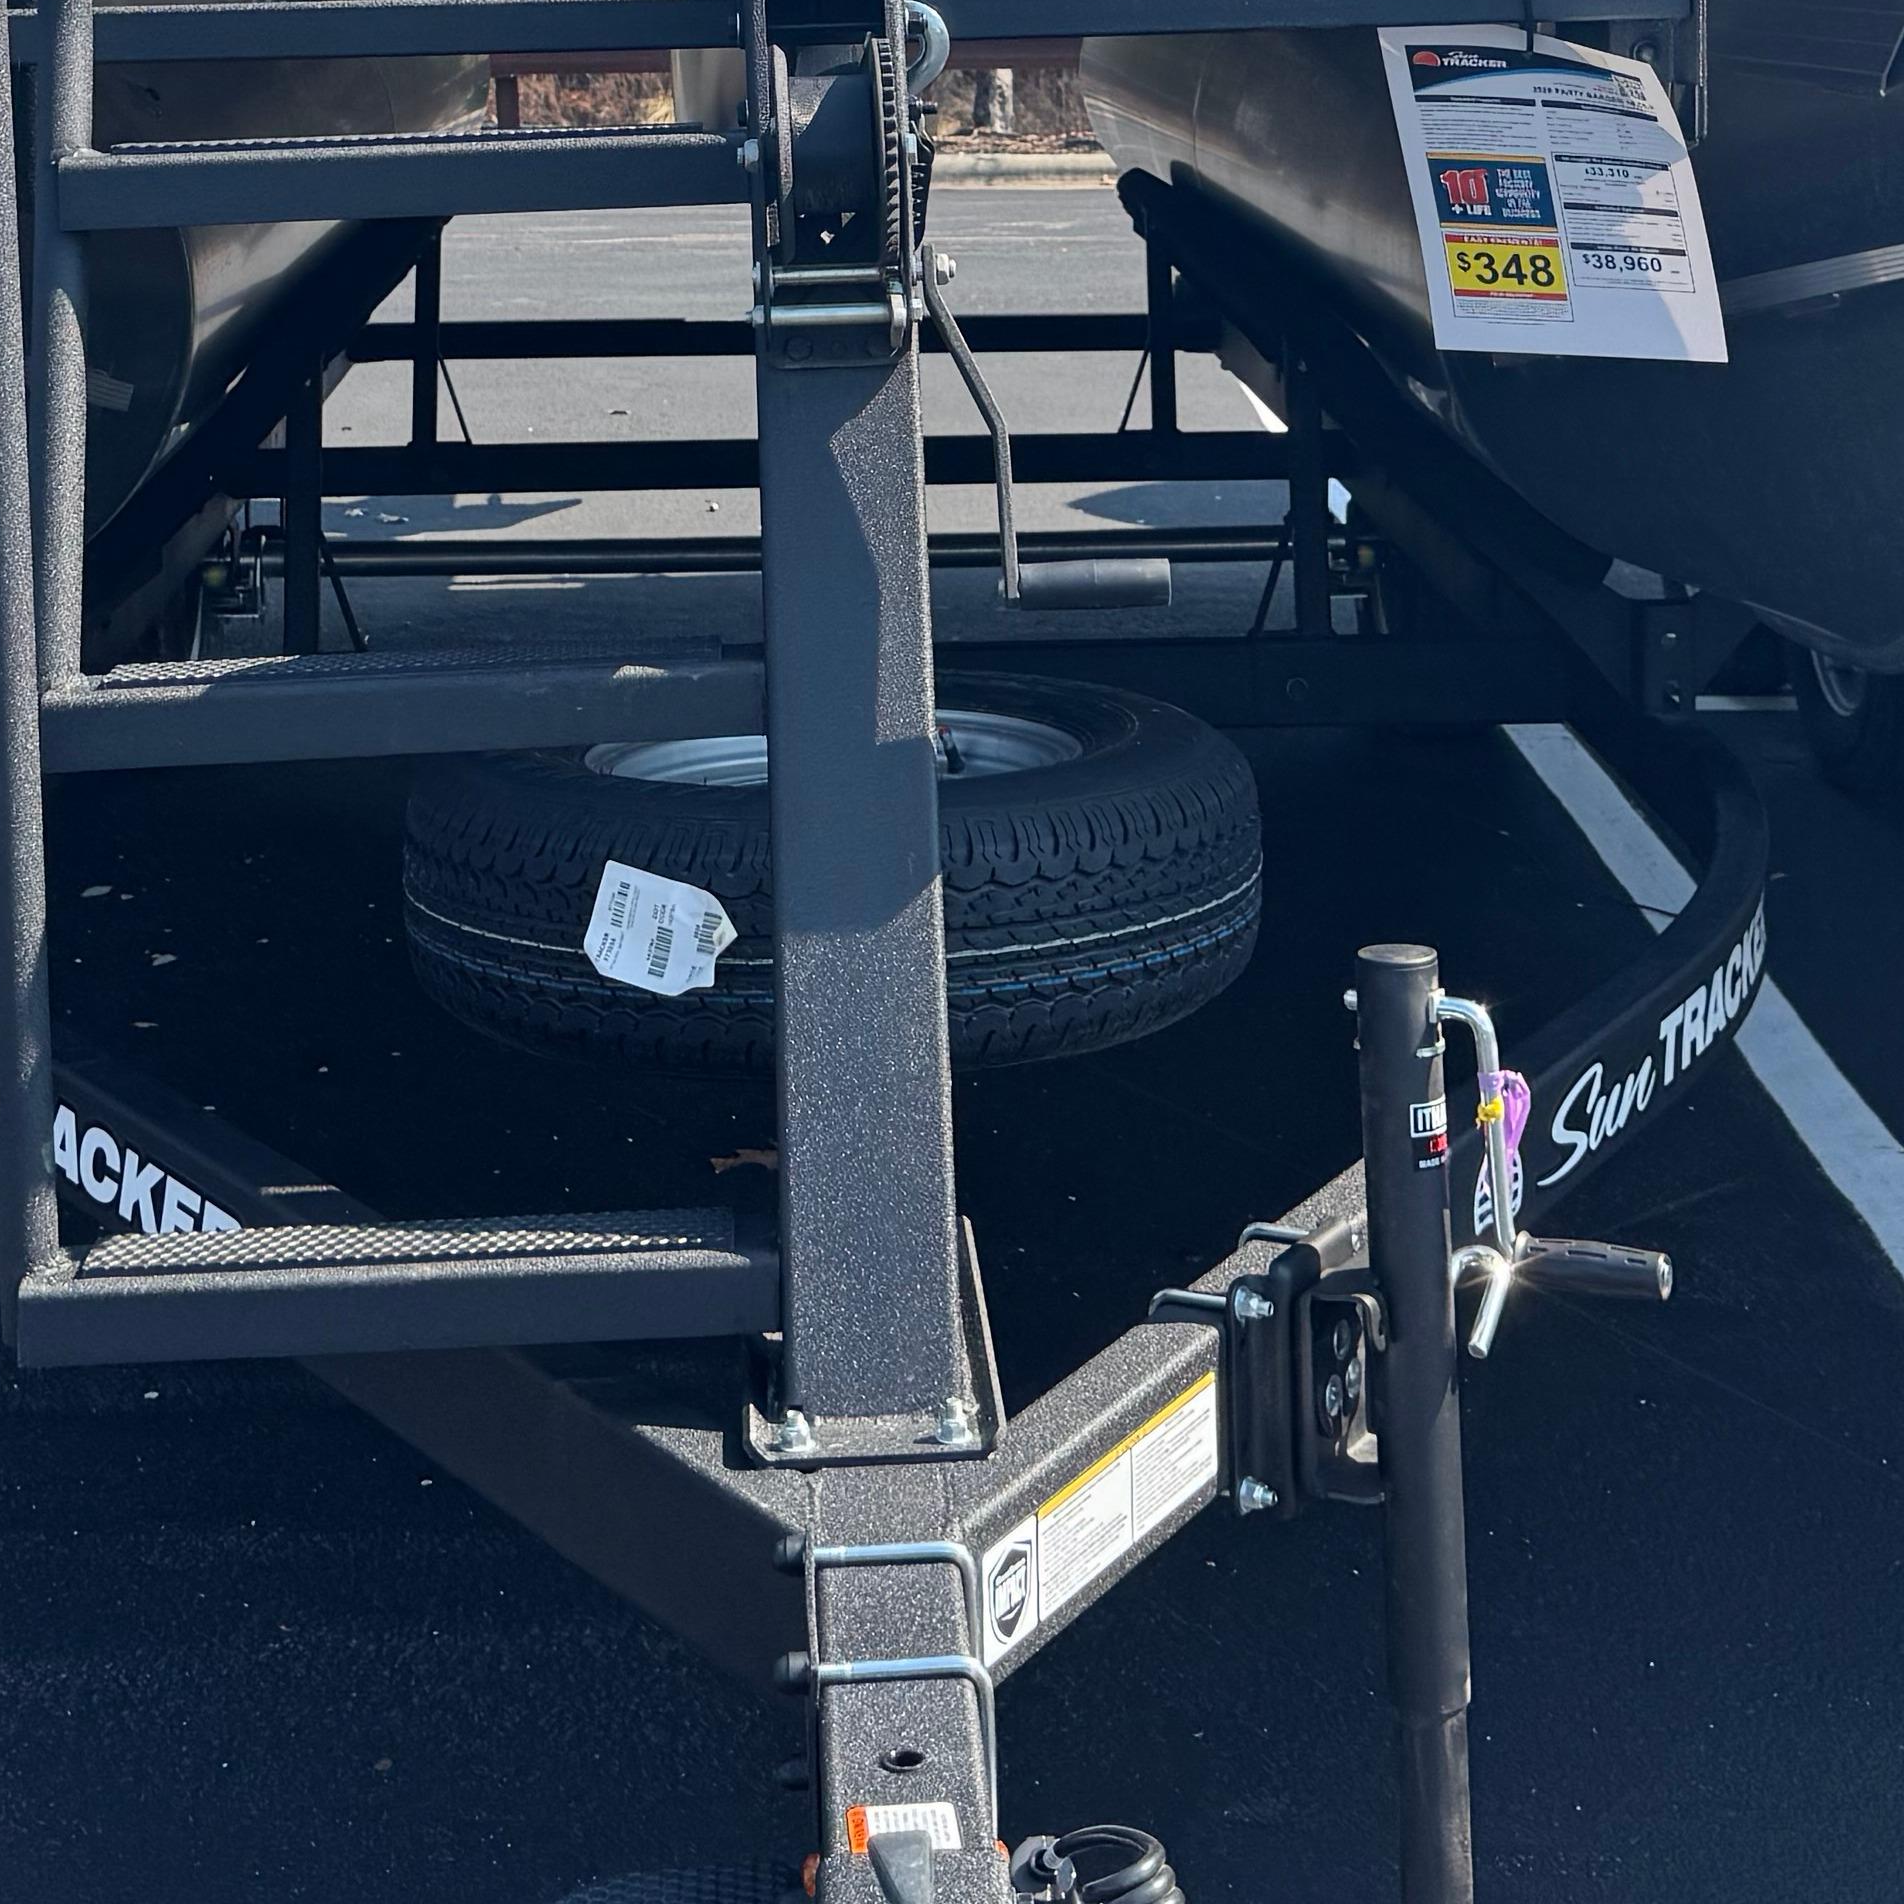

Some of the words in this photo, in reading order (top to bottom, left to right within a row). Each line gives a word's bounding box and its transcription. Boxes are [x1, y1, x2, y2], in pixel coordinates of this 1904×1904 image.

[1442, 57, 1507, 68] TRACKER
[1456, 251, 1555, 287] $348
[1582, 252, 1663, 274] $38,960
[1537, 1055, 1656, 1188] Sun
[1659, 887, 1768, 1086] TRACKE
